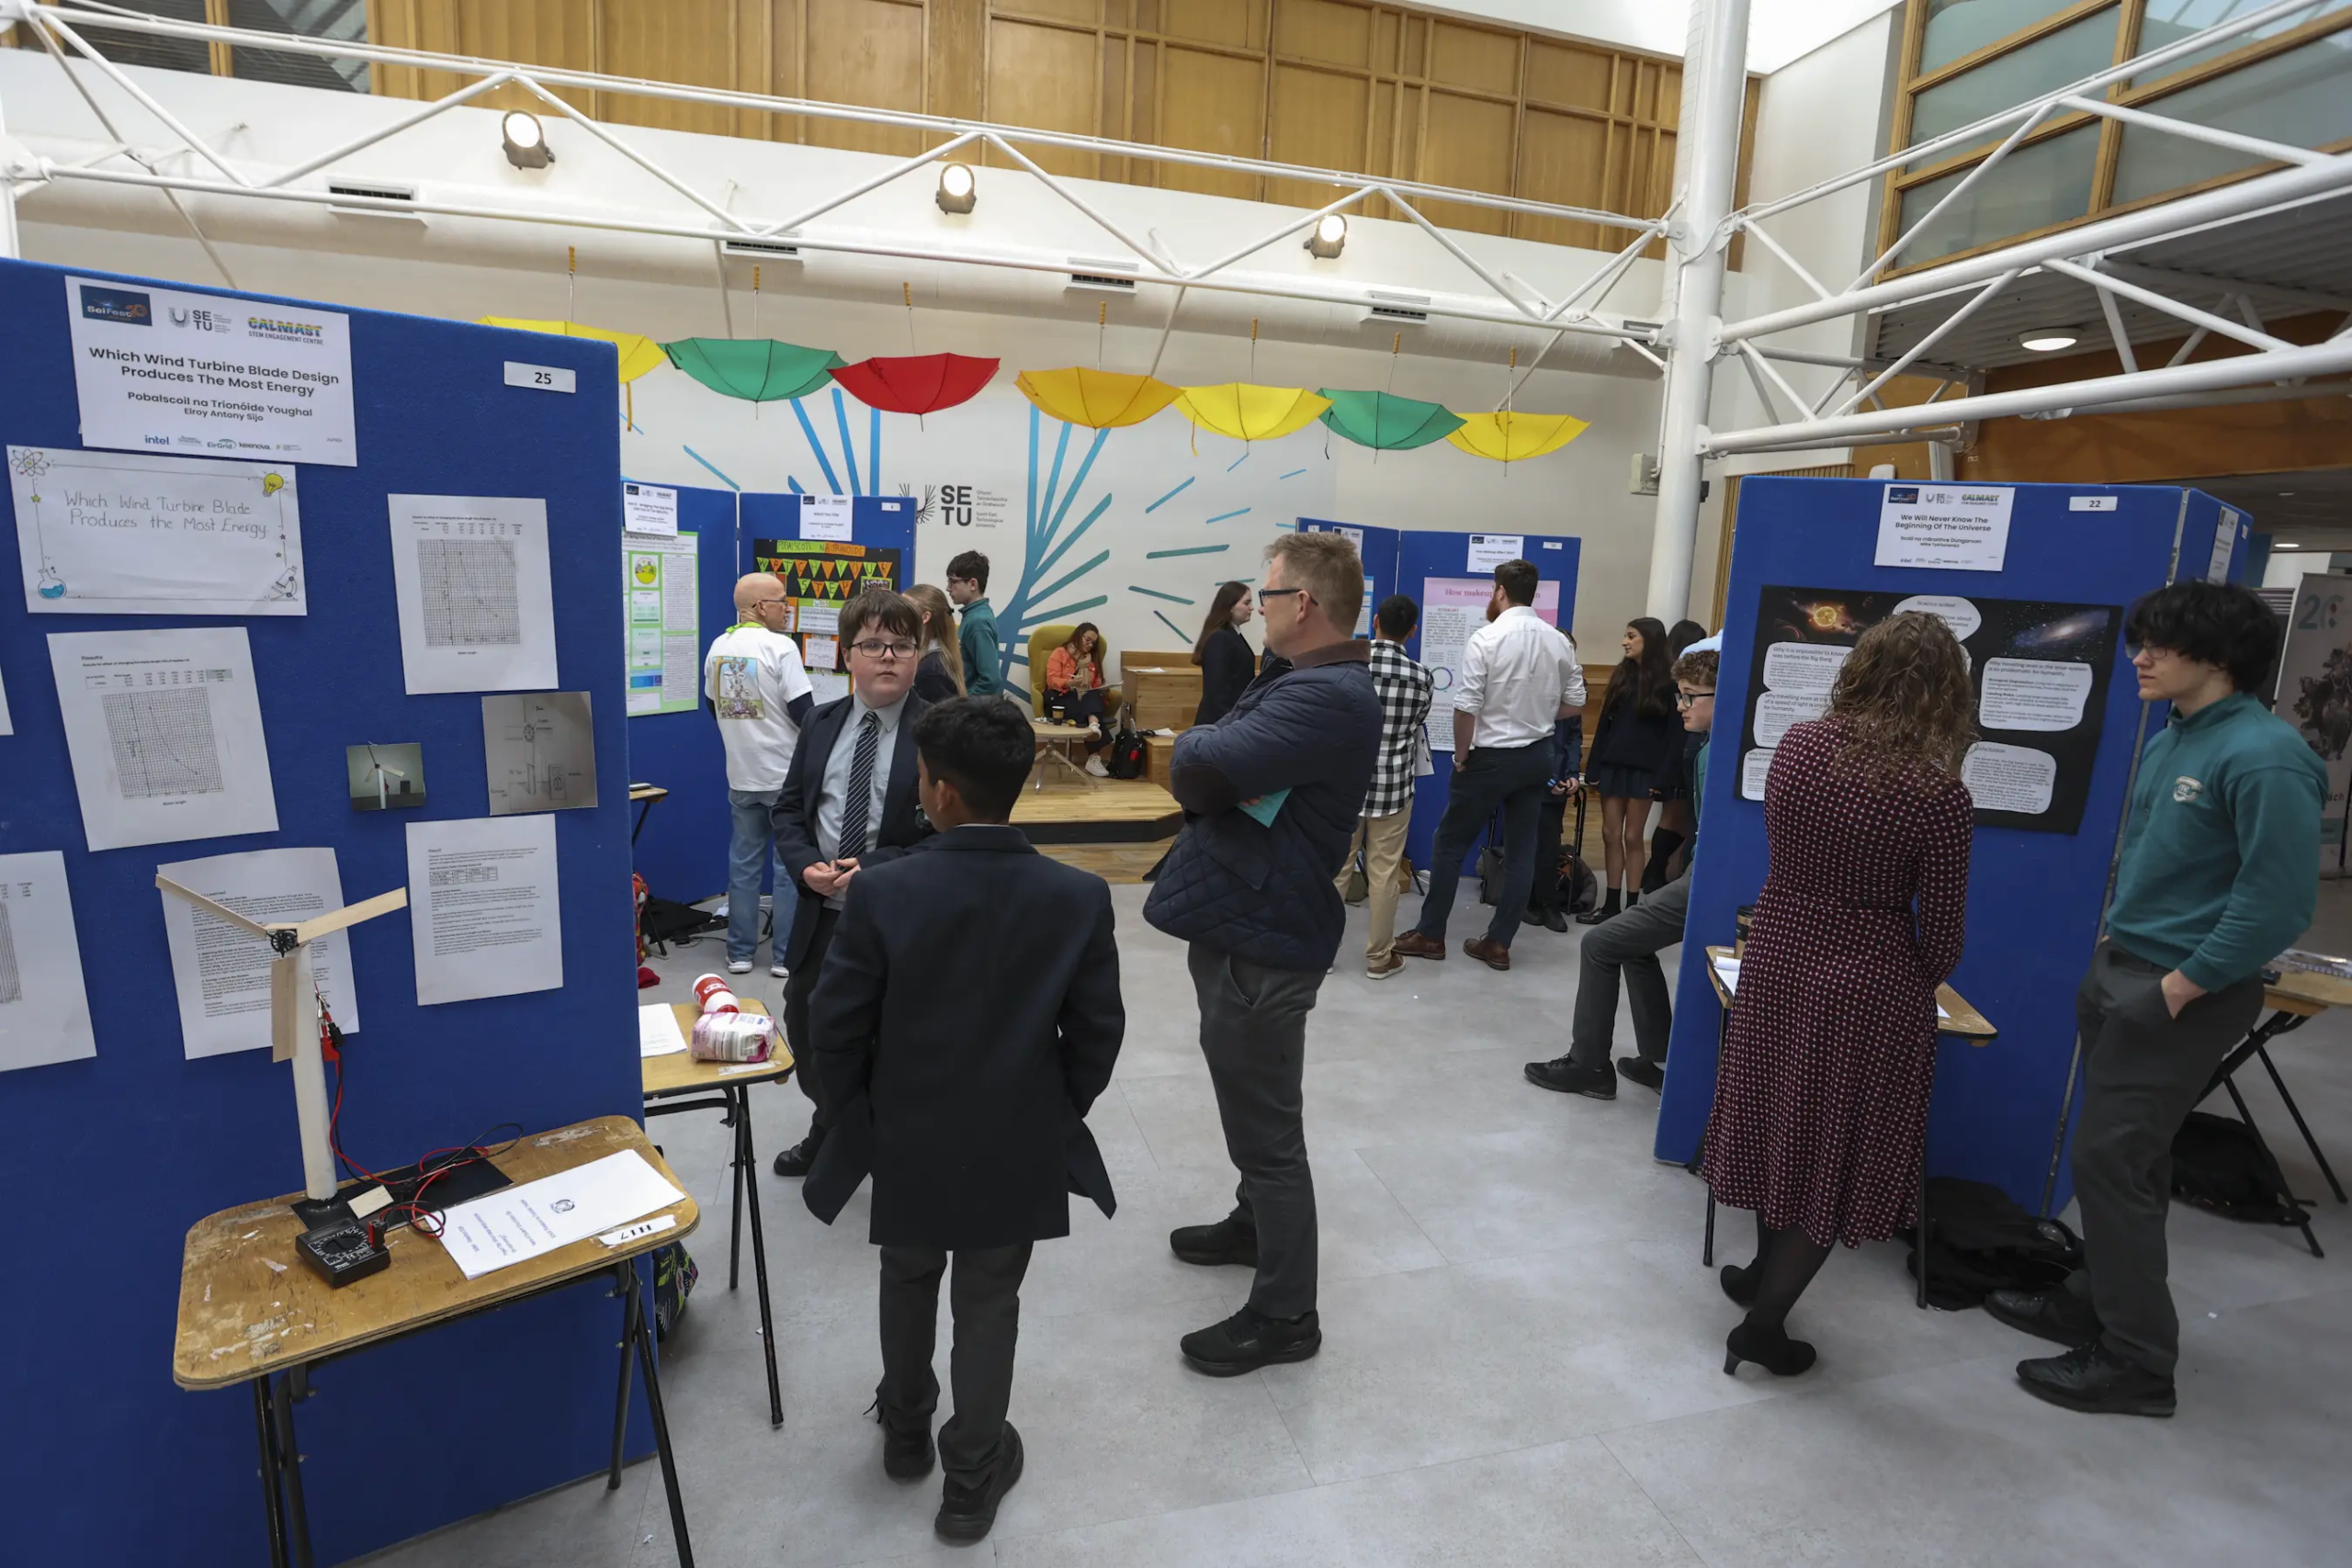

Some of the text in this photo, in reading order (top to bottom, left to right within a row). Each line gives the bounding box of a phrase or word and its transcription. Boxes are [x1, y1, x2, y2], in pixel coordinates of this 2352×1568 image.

[192, 310, 211, 321] SE
[194, 321, 213, 332] TU
[248, 317, 322, 337] CALMAST
[248, 331, 323, 345] STEM ENGAGEMENT CENTRE
[89, 347, 339, 386] Which Wind Turbine Blade Design
[121, 366, 314, 398] Produces The Most Energy
[535, 372, 551, 384] 25
[128, 391, 190, 405] Pobalscoil
[193, 399, 209, 407] na
[266, 405, 312, 418] Youghal
[184, 407, 264, 423] Elroy Antony Sijo
[144, 434, 169, 446] intel
[64, 490, 251, 514] Which Wind Turbine Blade
[941, 484, 972, 505] SE
[70, 508, 138, 528] Produces
[150, 514, 173, 530] the
[184, 517, 215, 532] Most
[941, 505, 972, 526] TU
[1895, 522, 1932, 530] Beginning
[802, 579, 848, 592] STEP
